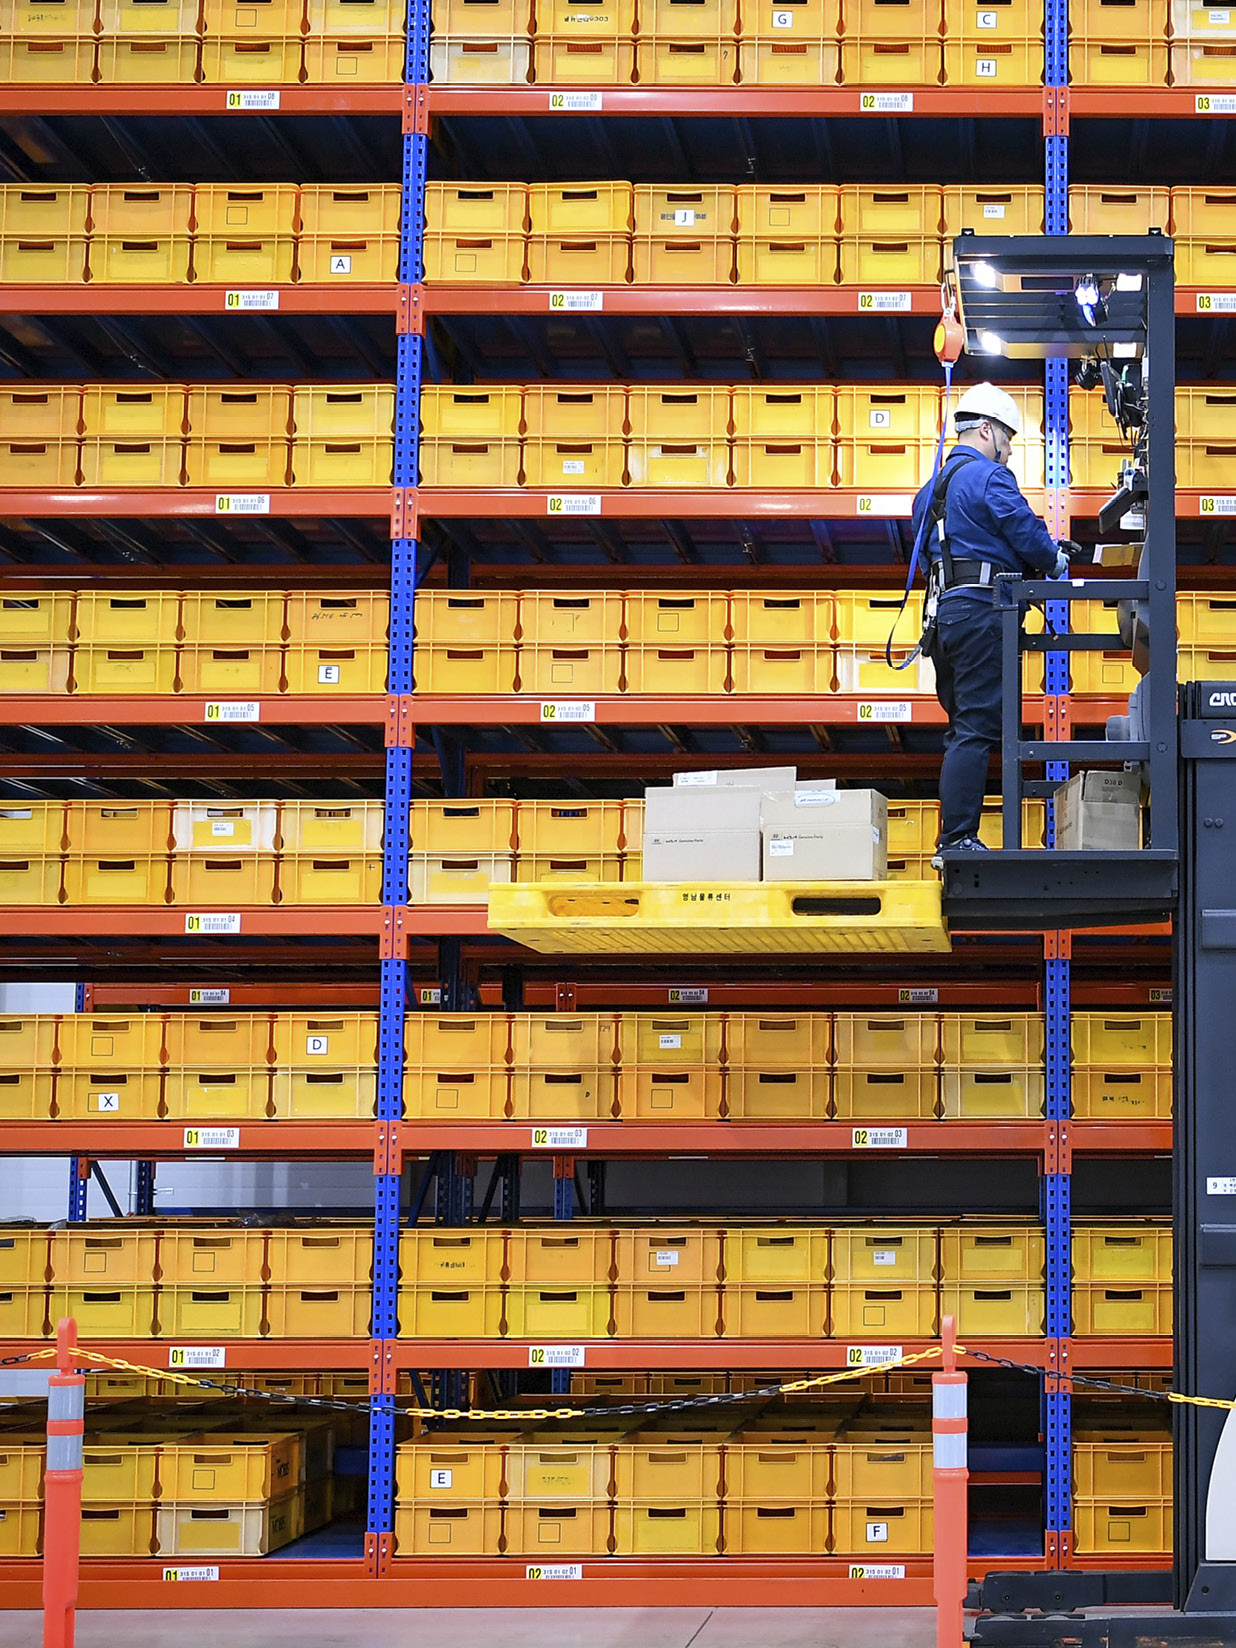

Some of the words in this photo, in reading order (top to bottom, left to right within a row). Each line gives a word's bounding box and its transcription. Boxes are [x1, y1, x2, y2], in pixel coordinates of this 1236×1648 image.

[778, 14, 787, 24] G
[983, 15, 990, 25] C
[982, 63, 990, 72] H
[229, 93, 240, 105] 01
[552, 95, 563, 107] 02
[863, 96, 874, 107] 02
[1198, 97, 1209, 109] 03
[682, 212, 687, 222] J
[336, 259, 345, 269] A
[228, 293, 239, 306] 01
[266, 292, 273, 300] 07
[552, 294, 564, 307] 02
[590, 293, 598, 301] 07
[861, 295, 872, 307] 02
[1199, 296, 1211, 308] 03
[876, 413, 884, 423] D
[219, 497, 229, 510] 01
[550, 498, 562, 511] 02
[860, 499, 871, 510] 02
[1202, 499, 1214, 511] 03
[325, 669, 332, 679] E
[208, 705, 219, 718] 01
[543, 705, 555, 717] 02
[860, 705, 872, 718] 02
[188, 916, 199, 929] 01
[227, 915, 235, 923] 04
[192, 991, 200, 1001] 01
[423, 991, 431, 1001] 01
[671, 990, 679, 1000] 02
[901, 990, 909, 1000] 02
[1152, 990, 1161, 1000] 03
[313, 1040, 322, 1050] D
[104, 1096, 113, 1107] X
[187, 1131, 198, 1144] 01
[535, 1130, 547, 1143] 02
[574, 1129, 582, 1137] 03
[855, 1131, 867, 1144] 02
[172, 1350, 183, 1363] 01
[212, 1349, 220, 1357] 02
[532, 1349, 544, 1362] 02
[572, 1348, 580, 1356] 02
[850, 1349, 862, 1362] 02
[890, 1348, 898, 1356] 02
[438, 1473, 445, 1484] E
[873, 1526, 880, 1537] F
[206, 1567, 214, 1575] 01
[529, 1568, 541, 1579] 02
[569, 1565, 577, 1573] 01
[852, 1568, 864, 1577] 02
[892, 1566, 900, 1574] 01
[166, 1570, 177, 1580] 01
